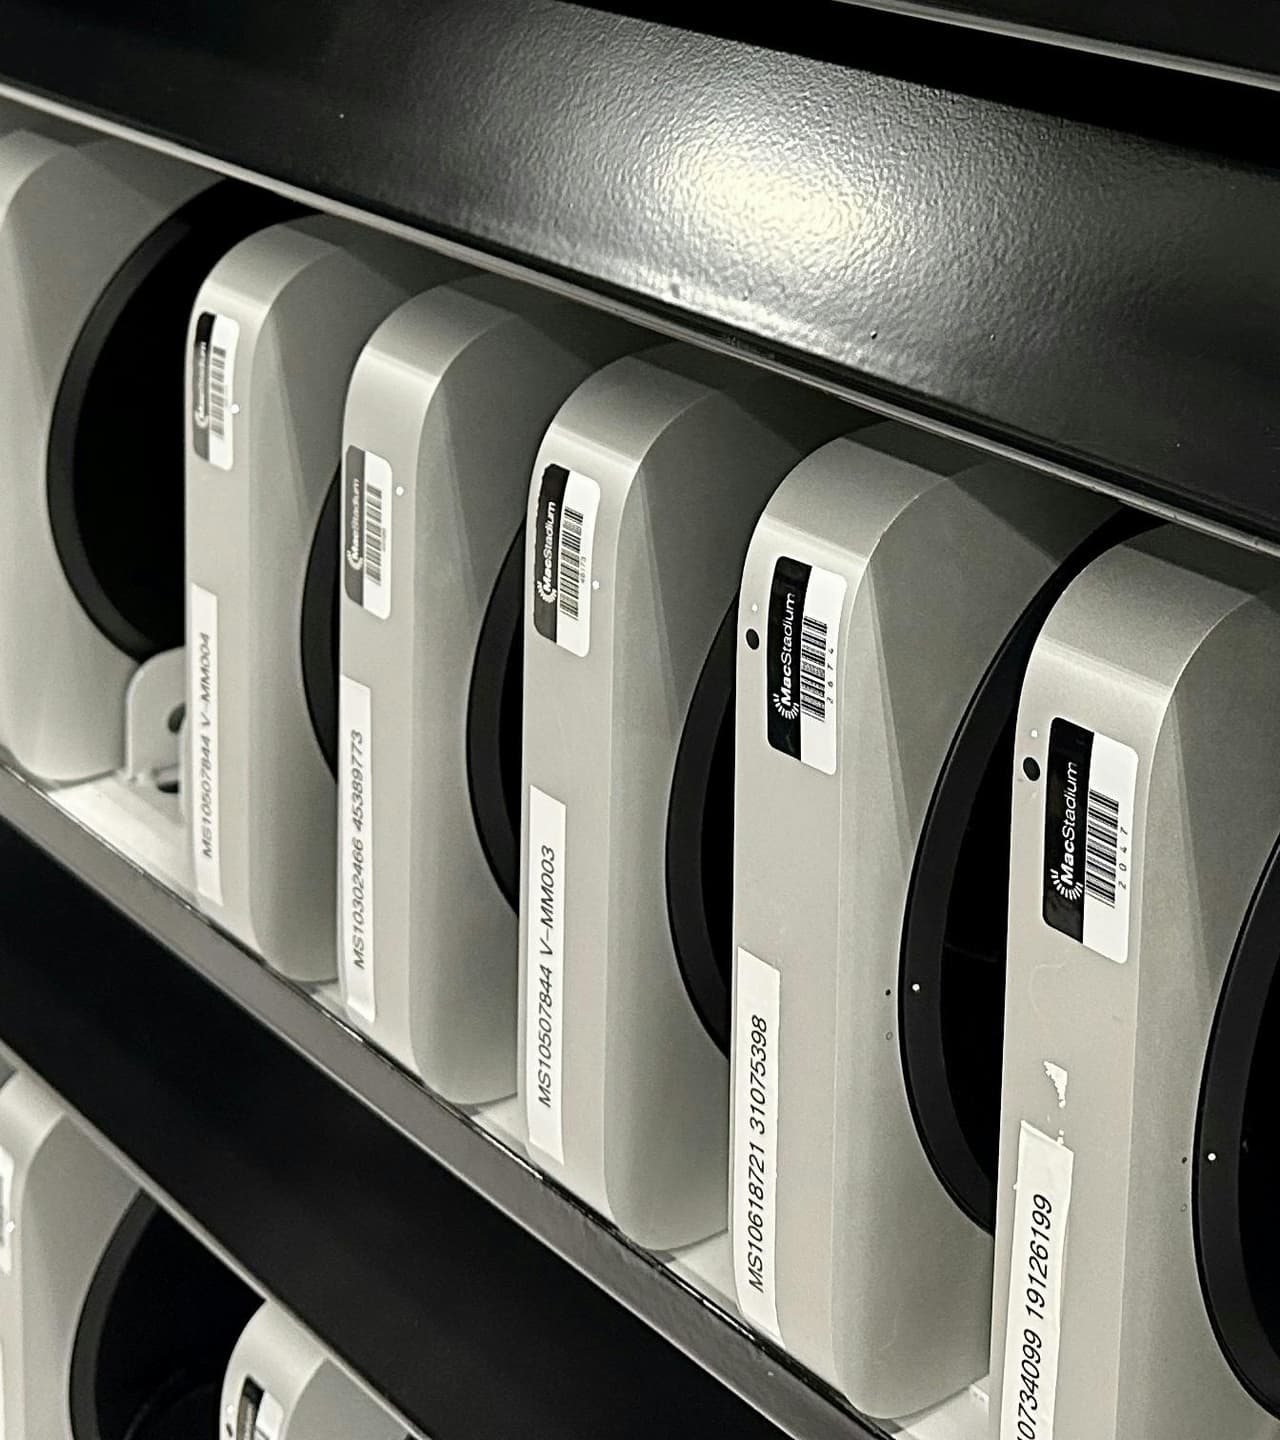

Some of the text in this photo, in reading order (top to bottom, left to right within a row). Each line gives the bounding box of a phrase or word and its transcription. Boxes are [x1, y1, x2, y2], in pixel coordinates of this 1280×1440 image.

[542, 501, 557, 593] MacStadium
[780, 592, 797, 707] MacStadium
[350, 730, 366, 971] MS10302466 45389773
[1060, 761, 1079, 886] MacStadium
[537, 844, 556, 1109] MS10507844 V-MM003
[747, 1015, 768, 1294] MS10618721 31075398
[1017, 1193, 1053, 1440] 0734099 19126199
